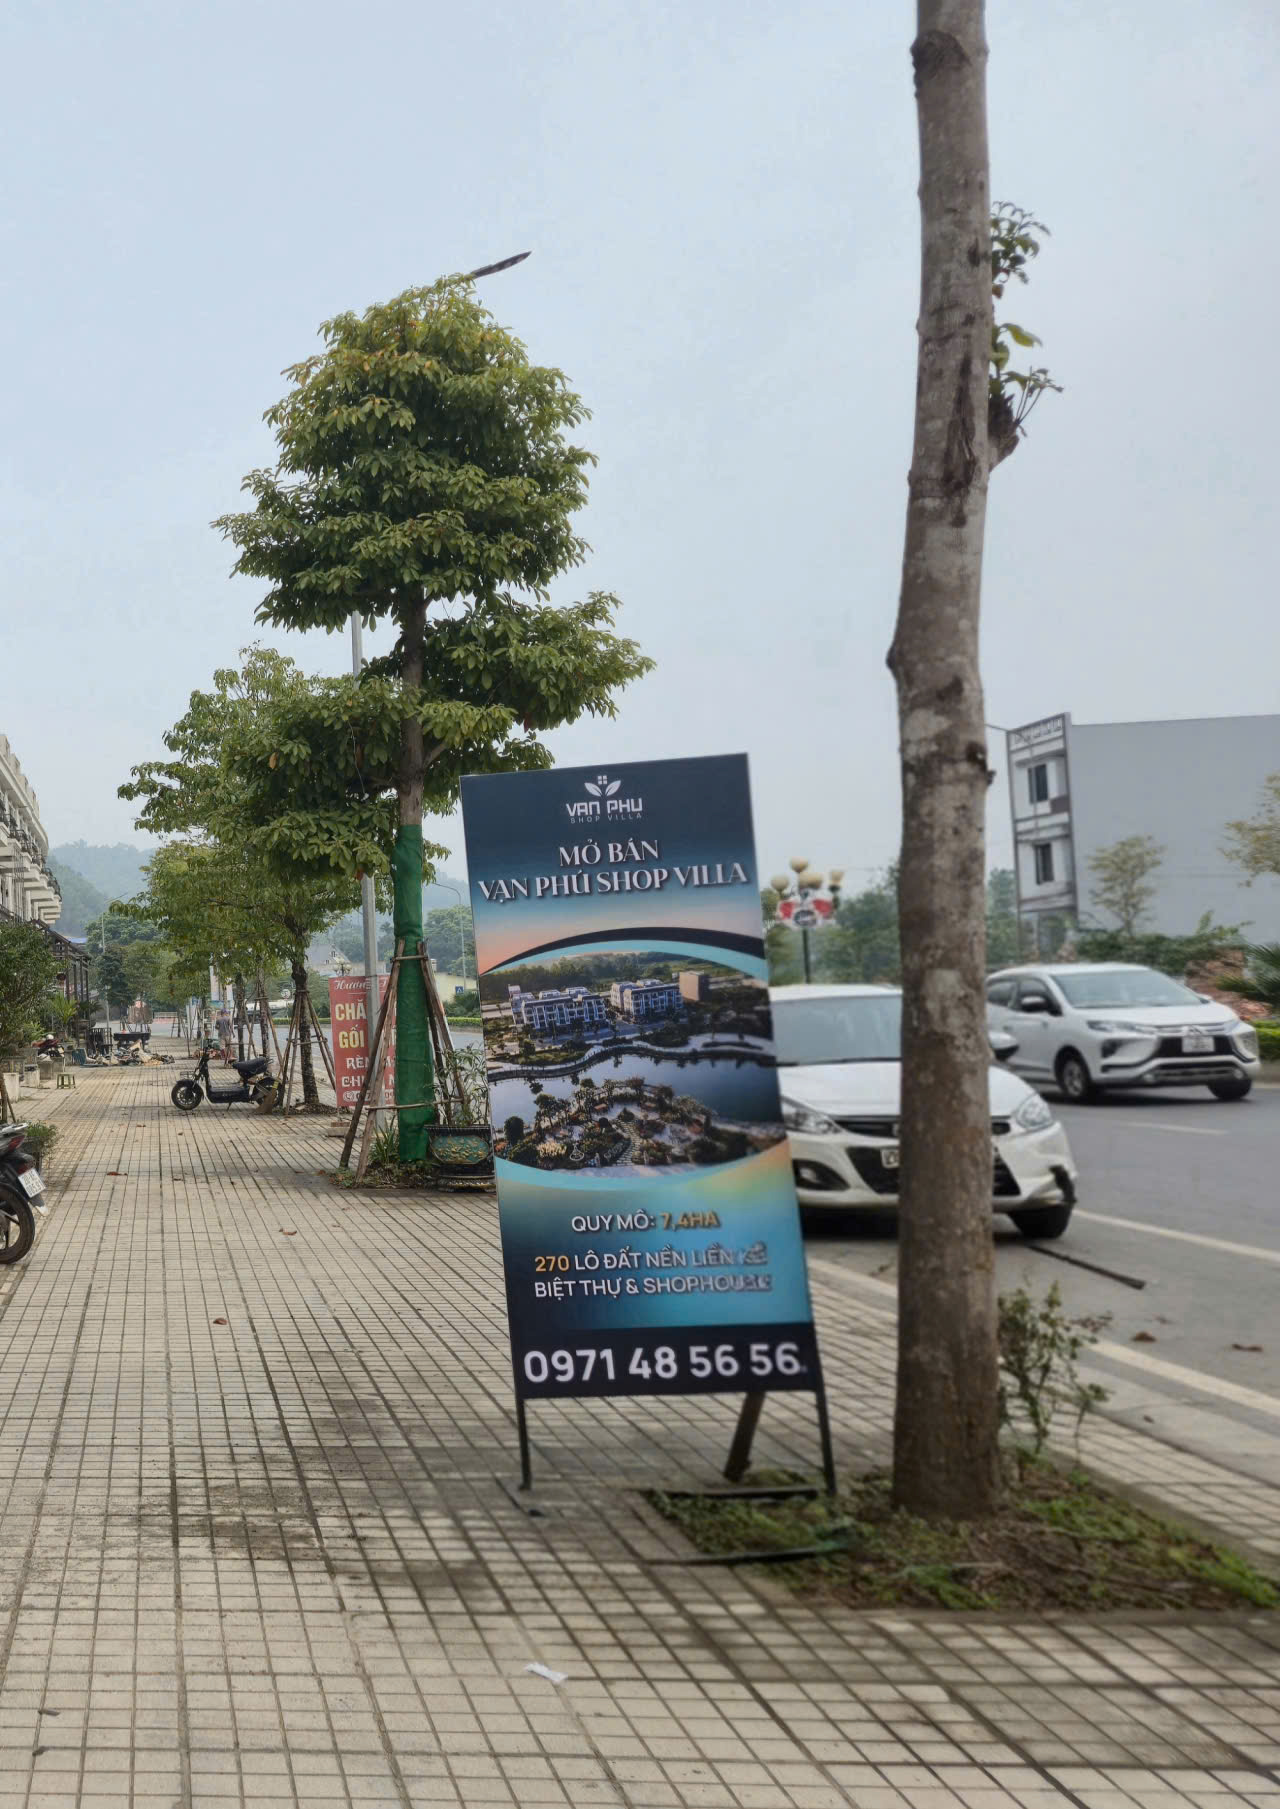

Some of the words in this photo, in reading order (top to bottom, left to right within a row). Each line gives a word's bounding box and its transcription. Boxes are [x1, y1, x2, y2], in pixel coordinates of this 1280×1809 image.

[566, 801, 601, 817] VAN
[606, 797, 643, 814] PHU
[570, 815, 600, 825] SHOP
[607, 812, 642, 821] VILLA
[559, 838, 601, 867] MỞ
[608, 837, 659, 864] BÁN
[478, 878, 529, 904] VẠN
[535, 869, 591, 898] PHÚ
[596, 867, 669, 895] SHOP
[673, 862, 748, 887] VILLA
[339, 1024, 365, 1049] GỐI
[571, 1214, 613, 1232] QUY
[617, 1209, 655, 1230] MÔ:
[660, 1212, 719, 1231] 7,4HA
[535, 1256, 570, 1272] 270
[574, 1250, 600, 1271] LÔ
[603, 1246, 641, 1270] ĐẤT
[646, 1244, 686, 1267] NỀN
[691, 1242, 734, 1266] LIỀN
[534, 1277, 576, 1301] BIỆT
[579, 1277, 622, 1299] THỰ
[626, 1279, 639, 1294] &
[643, 1274, 770, 1295] SHOPHOUSE
[523, 1348, 616, 1383] 0971
[628, 1346, 678, 1379] 48
[689, 1344, 739, 1378] 56
[749, 1342, 802, 1376] 56
